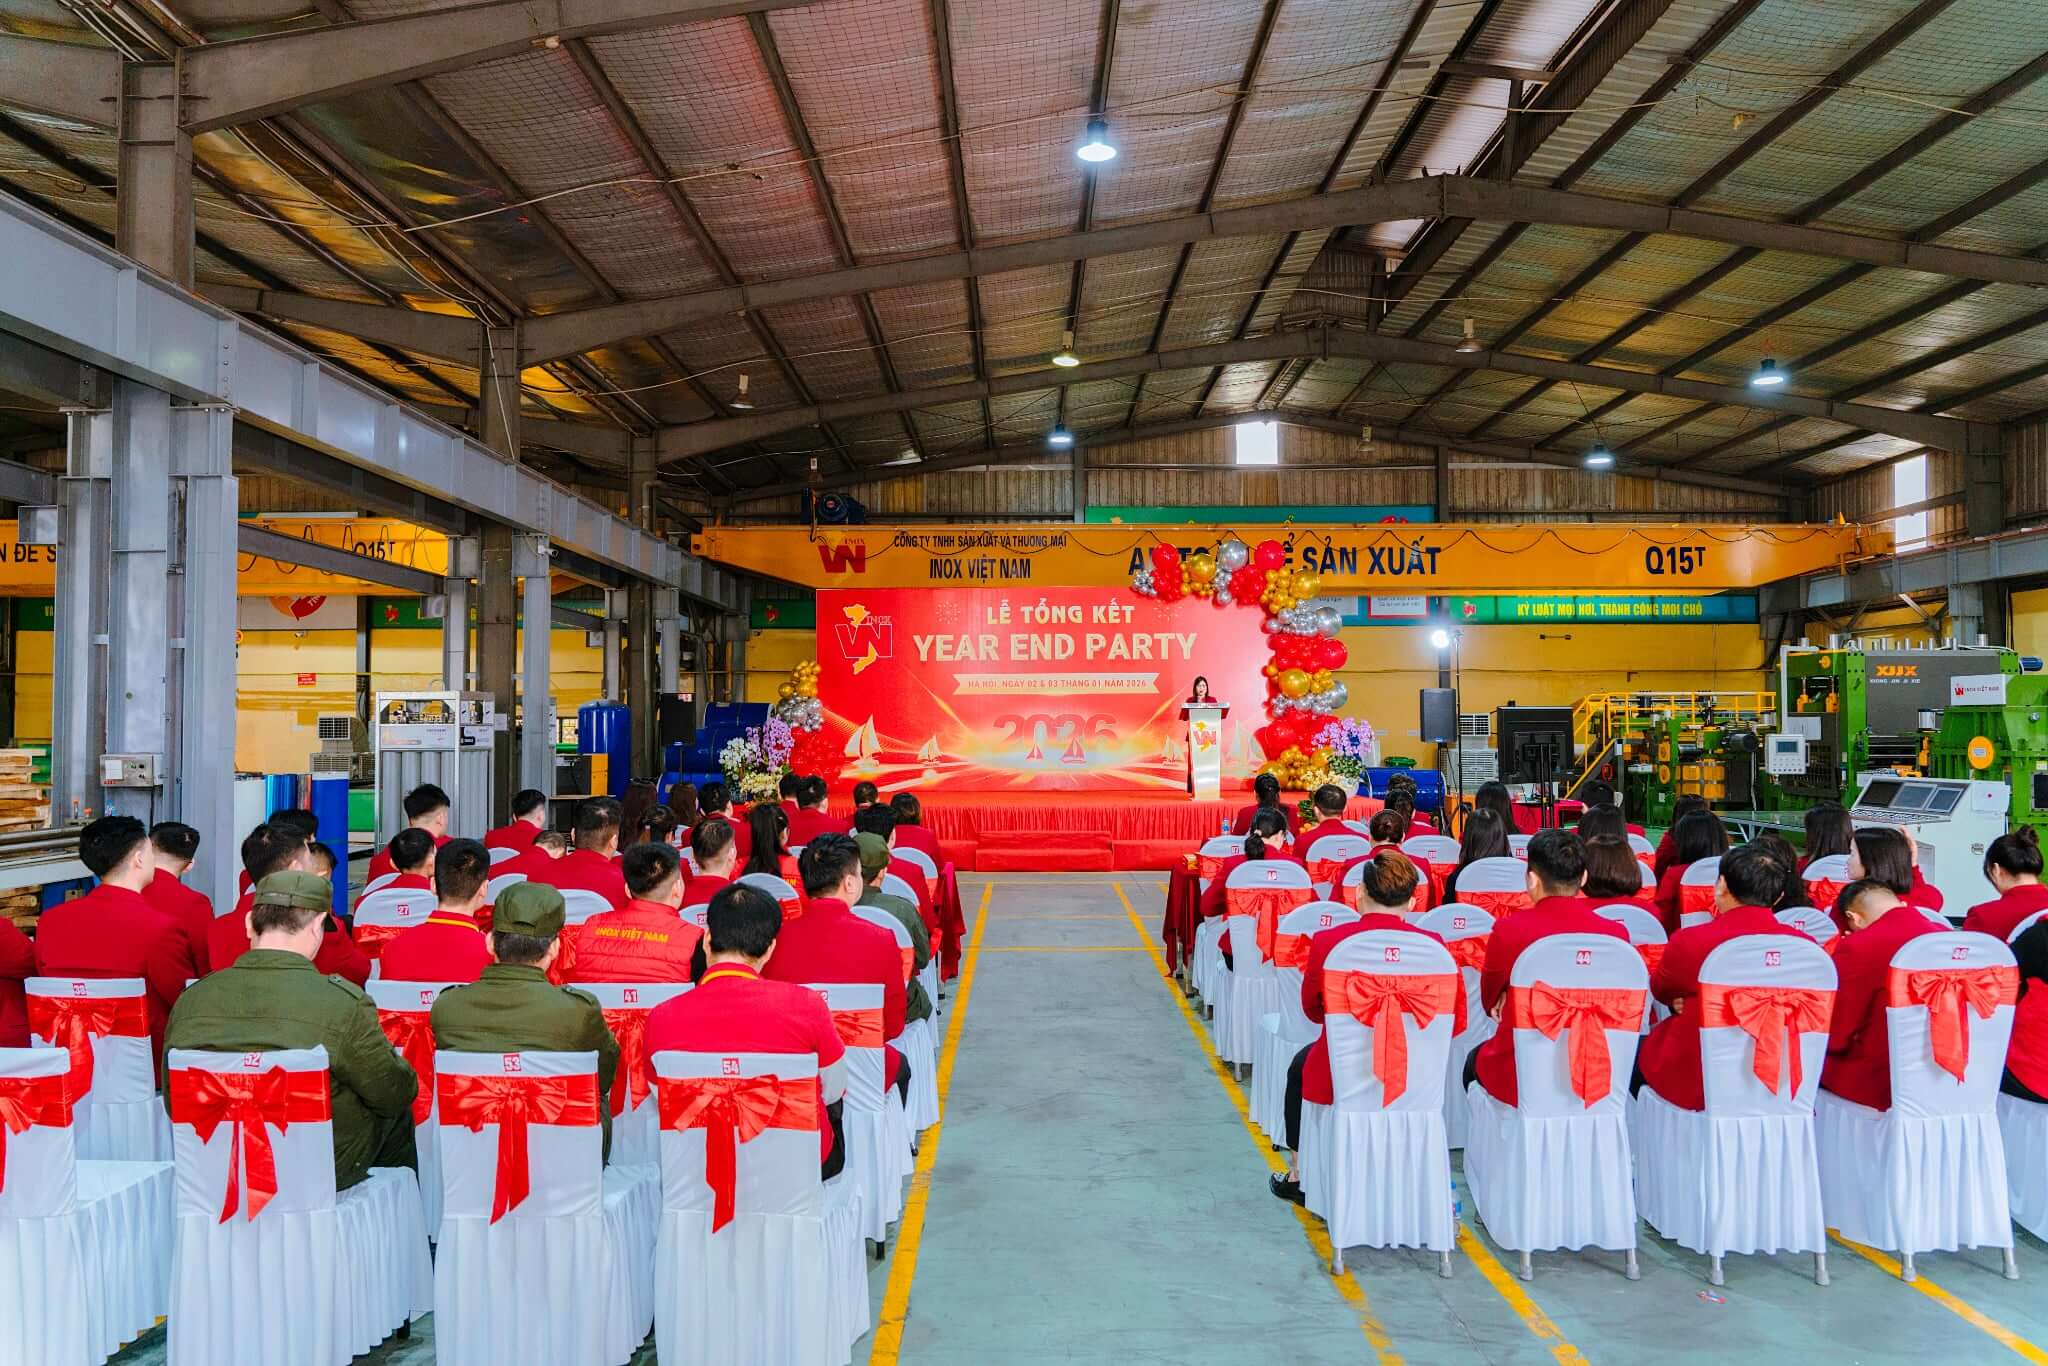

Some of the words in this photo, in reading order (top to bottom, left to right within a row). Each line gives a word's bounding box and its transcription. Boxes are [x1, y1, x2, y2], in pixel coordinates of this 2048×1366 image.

[920, 535, 930, 547] TY
[933, 535, 955, 547] TNHH
[1368, 534, 1442, 575] XUẤT
[929, 558, 963, 579] INOX
[967, 553, 997, 584] VIỆT
[1000, 558, 1031, 579] NAM
[987, 599, 1011, 625] LỄ
[1020, 597, 1083, 625] TỔNG
[1092, 597, 1135, 625] KẾT
[912, 634, 1000, 662] YEAR
[1009, 633, 1075, 661] END
[1085, 632, 1198, 660] PARTY
[1027, 679, 1037, 688] 02
[1048, 679, 1058, 688] 03
[1126, 679, 1147, 688] 2026
[1320, 915, 1332, 926] 31
[1454, 918, 1465, 929] 32
[1385, 947, 1400, 961] 43
[1576, 951, 1591, 965] 44
[1765, 952, 1781, 966] 45
[624, 990, 637, 1002] 41
[244, 1053, 260, 1067] 52
[504, 1055, 521, 1071] 53
[722, 1059, 740, 1074] 54
